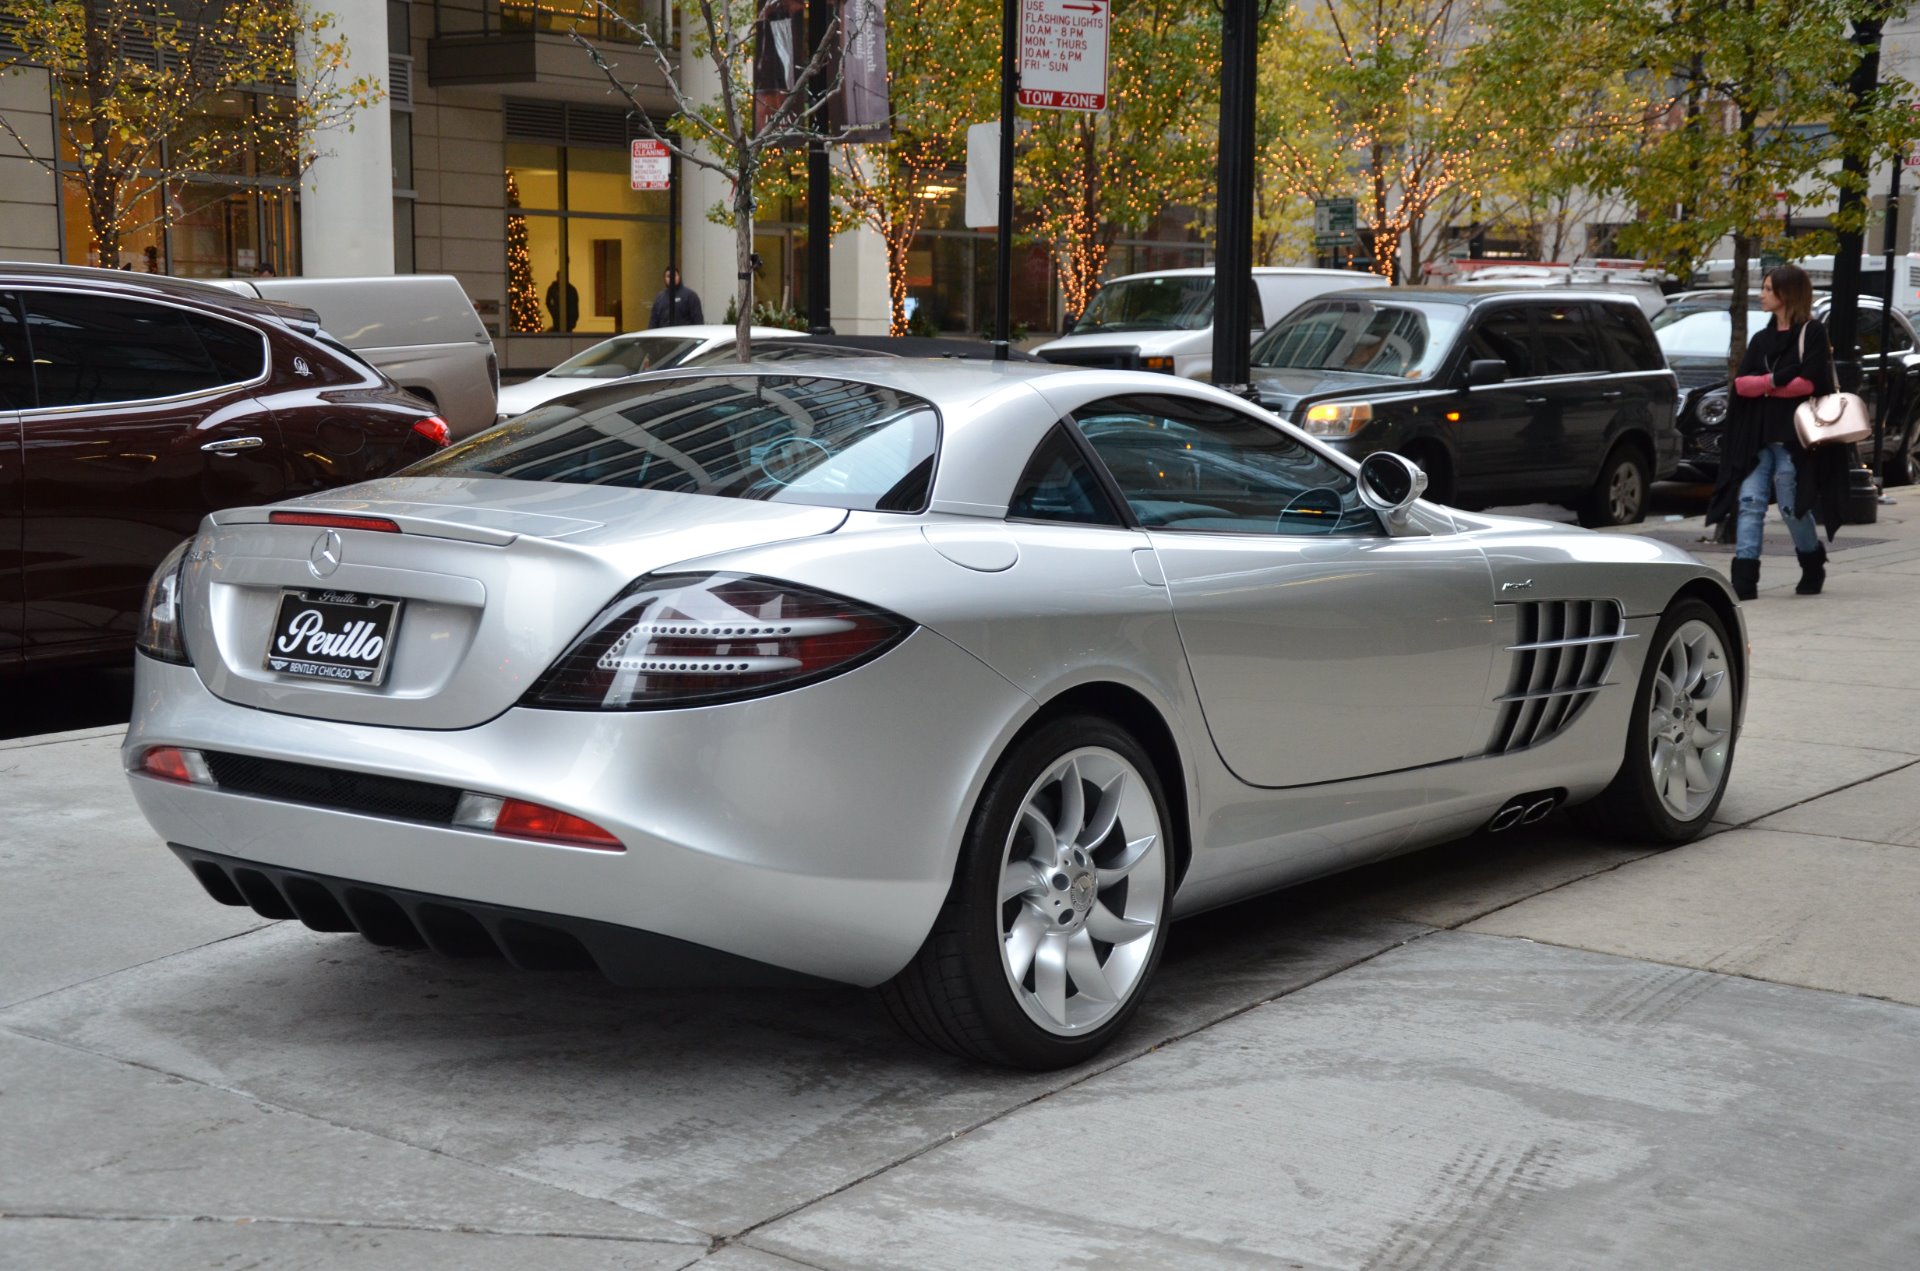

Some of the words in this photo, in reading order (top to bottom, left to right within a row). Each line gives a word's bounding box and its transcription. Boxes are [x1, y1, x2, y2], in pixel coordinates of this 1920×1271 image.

[1026, 1, 1044, 11] USE
[1026, 12, 1070, 26] FLASHING
[1072, 16, 1104, 29] LIGHTS
[1026, 24, 1035, 34] 10
[1037, 25, 1051, 35] AM
[1061, 27, 1067, 37] 8
[1070, 28, 1084, 38] PM
[1025, 37, 1046, 47] MON
[1057, 39, 1088, 50] THURS
[1025, 48, 1034, 58] 10
[1035, 49, 1050, 59] AM
[1060, 51, 1066, 60] 6
[1068, 52, 1082, 61] PM
[1024, 60, 1040, 70] FRI
[1049, 61, 1069, 72] SUN
[1024, 90, 1054, 105] TOW
[1061, 94, 1098, 108] ZONE
[278, 610, 383, 661] Perillo
[290, 663, 318, 675] BENTLEY
[318, 666, 352, 679] CHICAGO
